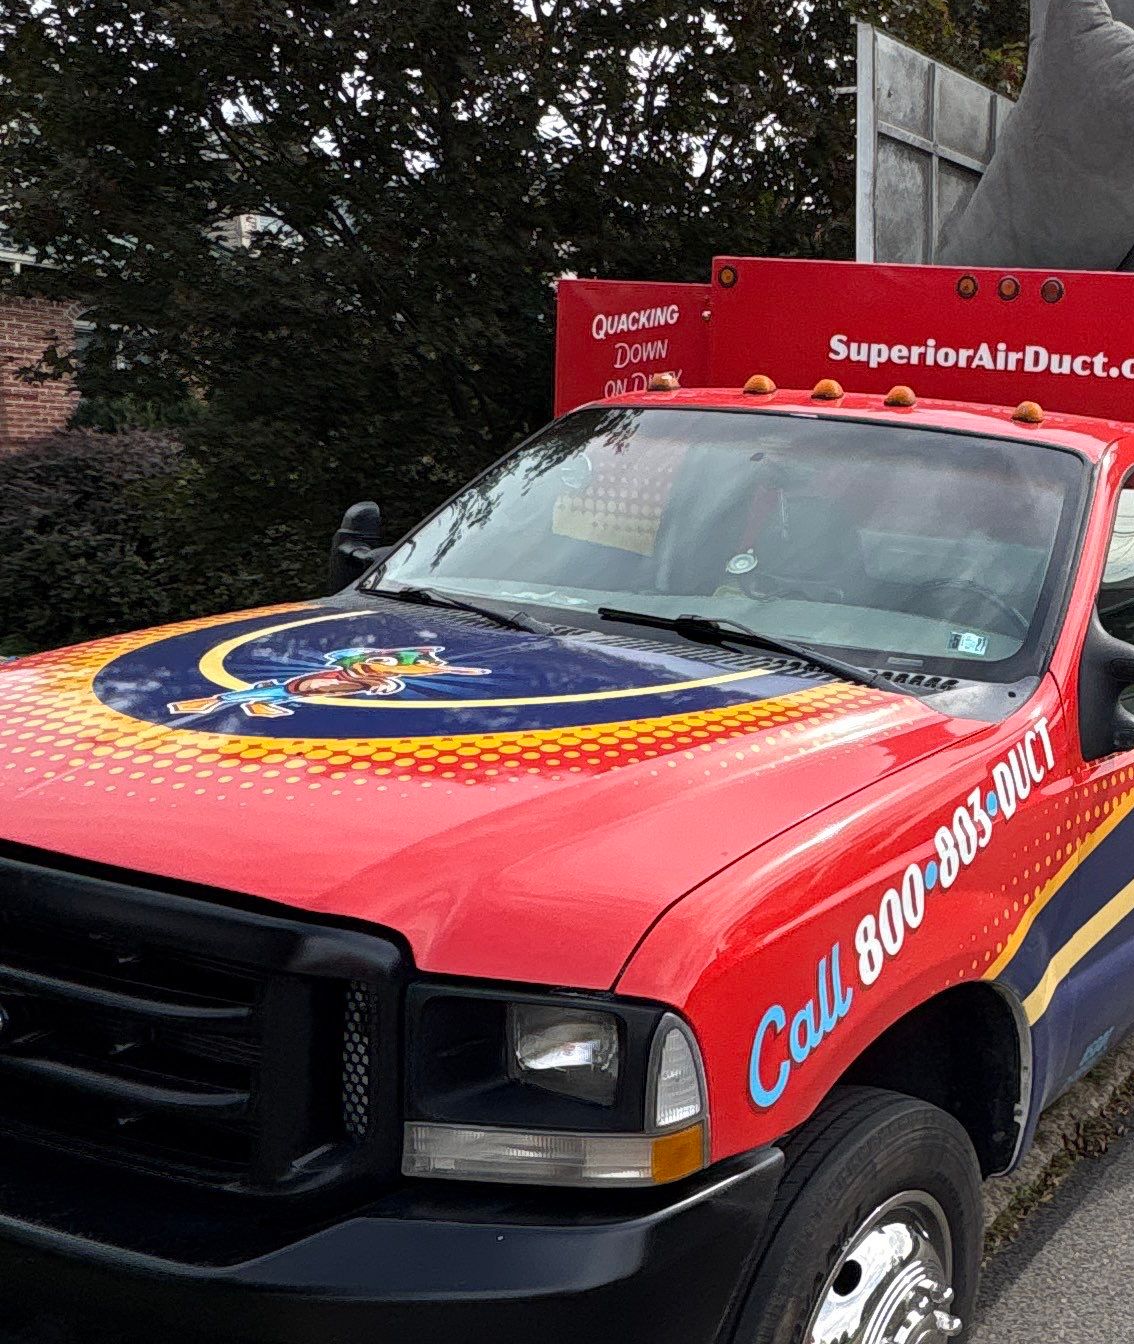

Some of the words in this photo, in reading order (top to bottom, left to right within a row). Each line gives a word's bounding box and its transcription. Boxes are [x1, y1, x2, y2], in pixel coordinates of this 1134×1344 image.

[592, 304, 679, 340] QUACKING
[613, 339, 669, 369] DOWN
[748, 942, 854, 1108] Call
